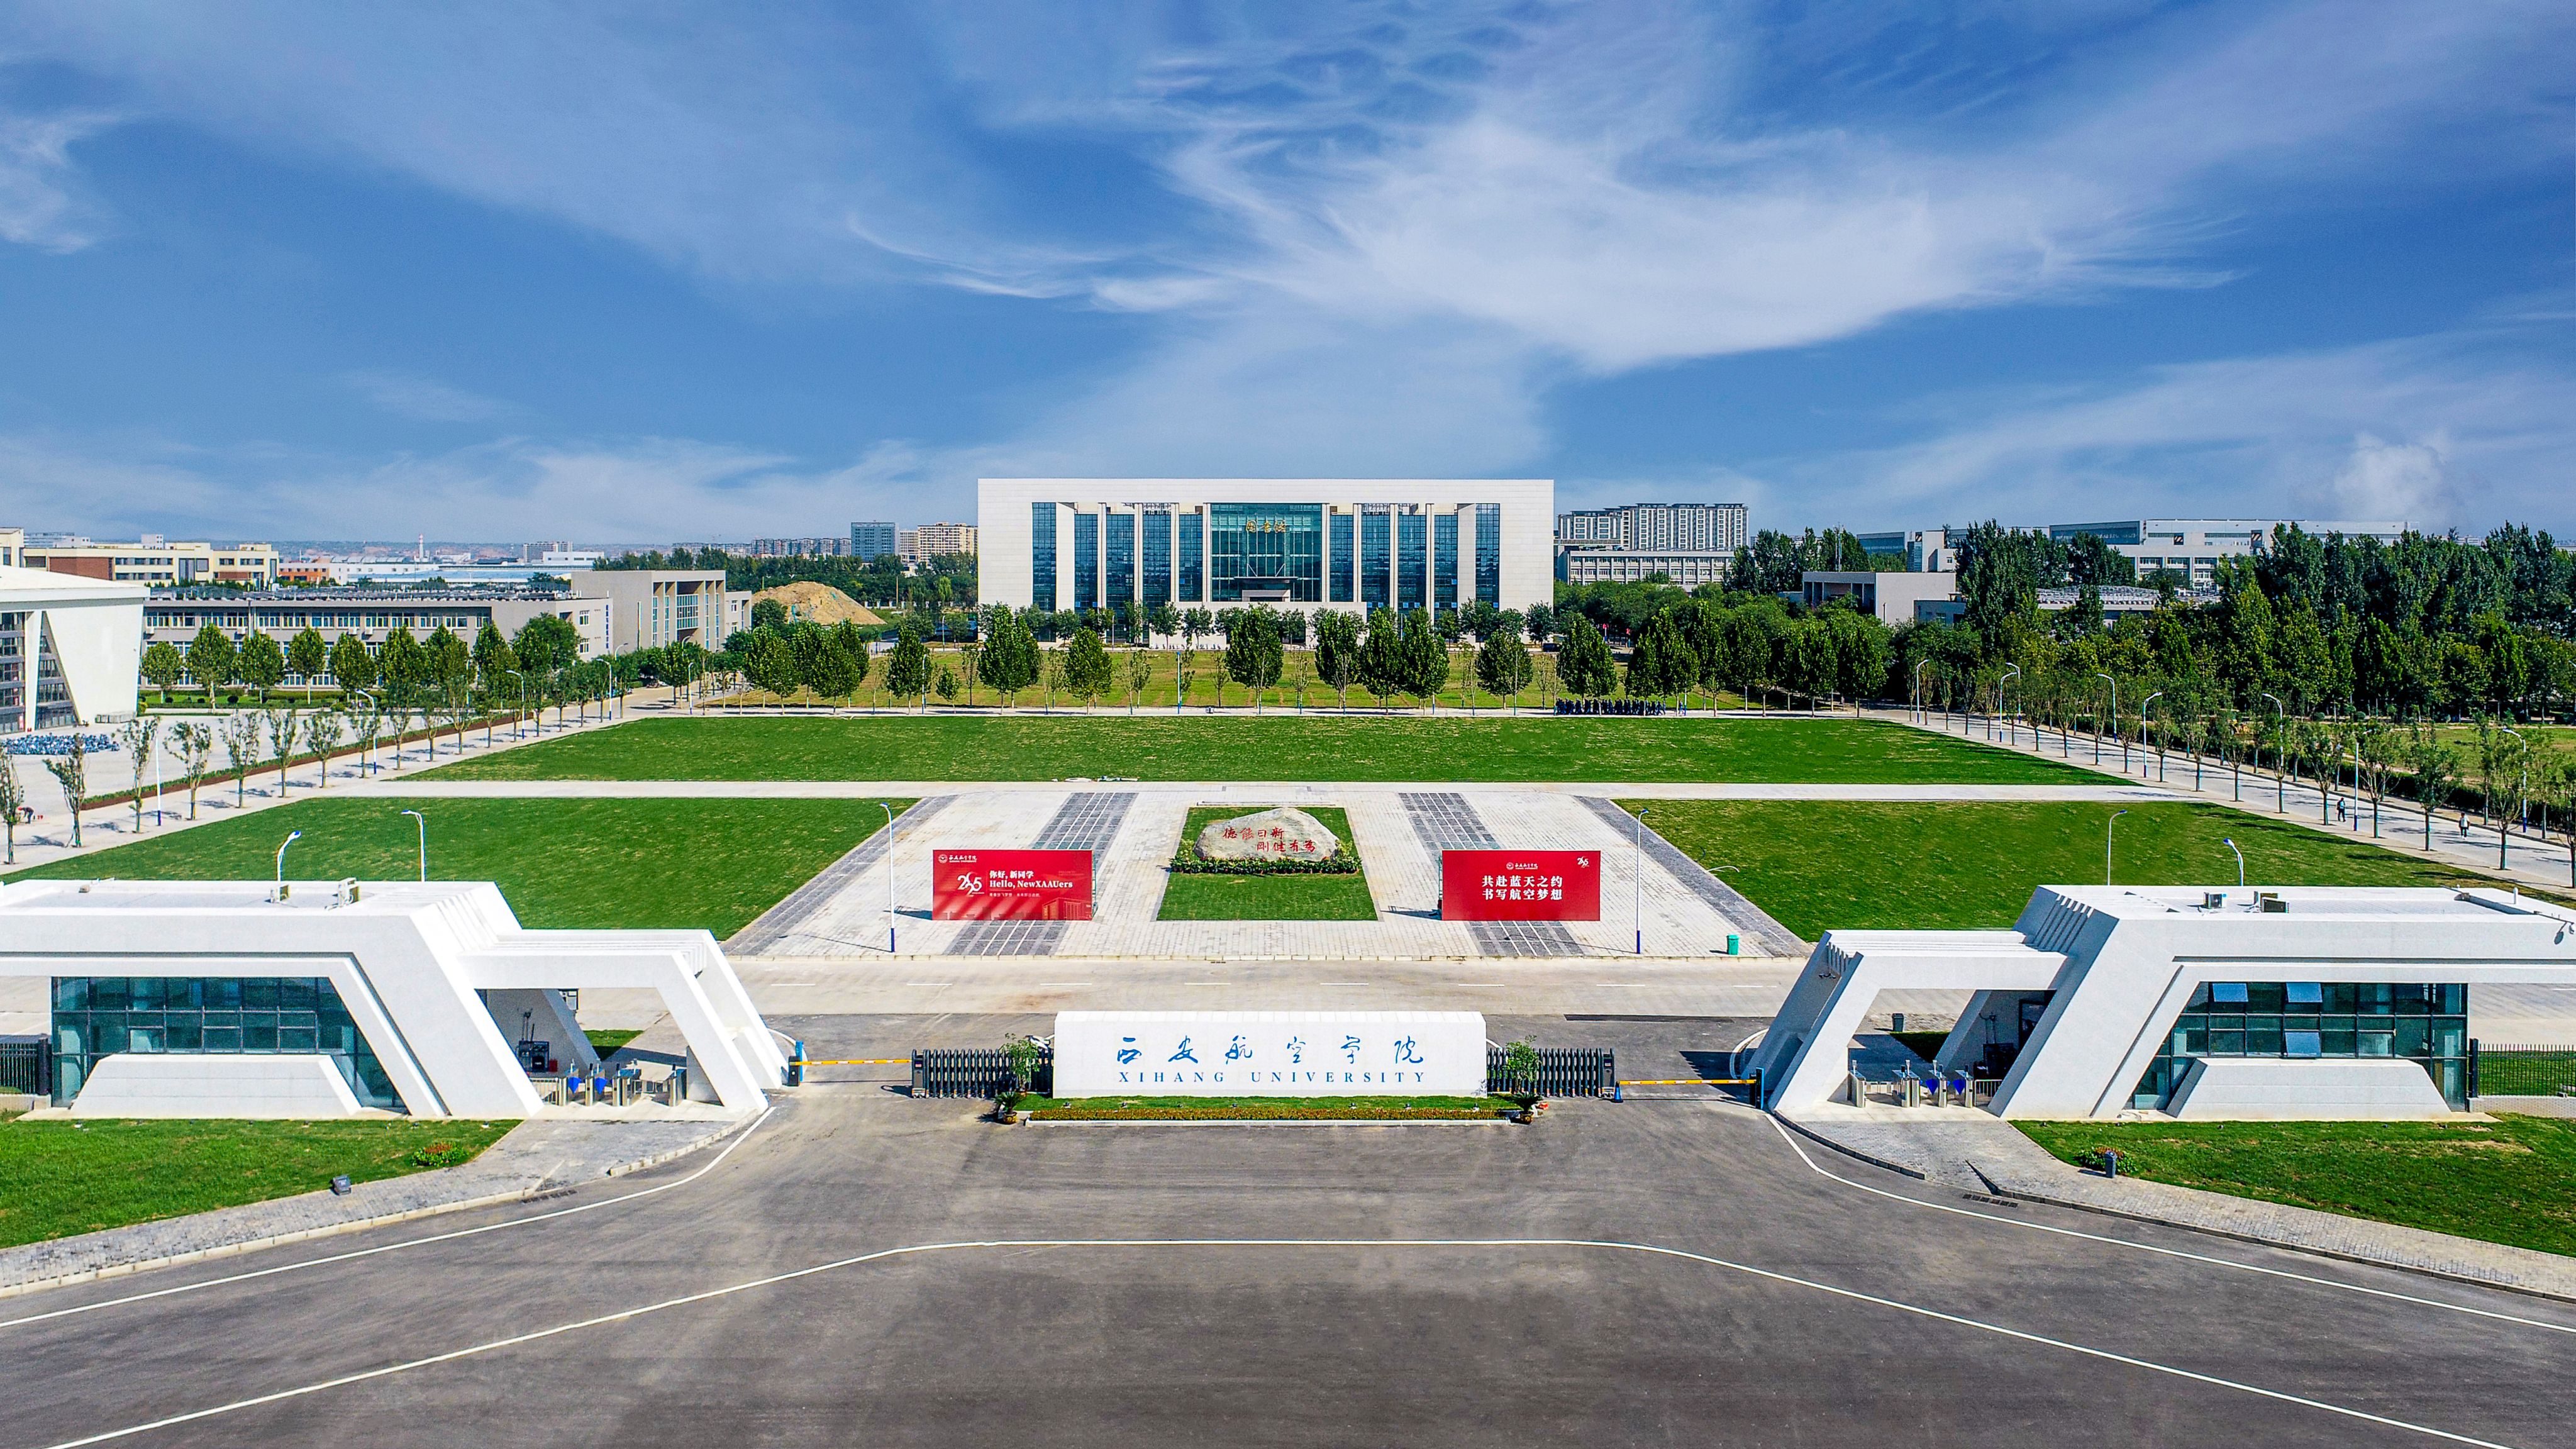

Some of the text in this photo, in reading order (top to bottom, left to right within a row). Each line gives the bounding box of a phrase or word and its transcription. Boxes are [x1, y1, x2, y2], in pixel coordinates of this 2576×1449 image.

[989, 880, 1016, 889] Hello,
[1482, 875, 1563, 887] 共赴蓝天之约
[1482, 888, 1562, 901] 书写航空梦想
[1119, 1072, 1424, 1082] XIHANG UNIVERSITY
